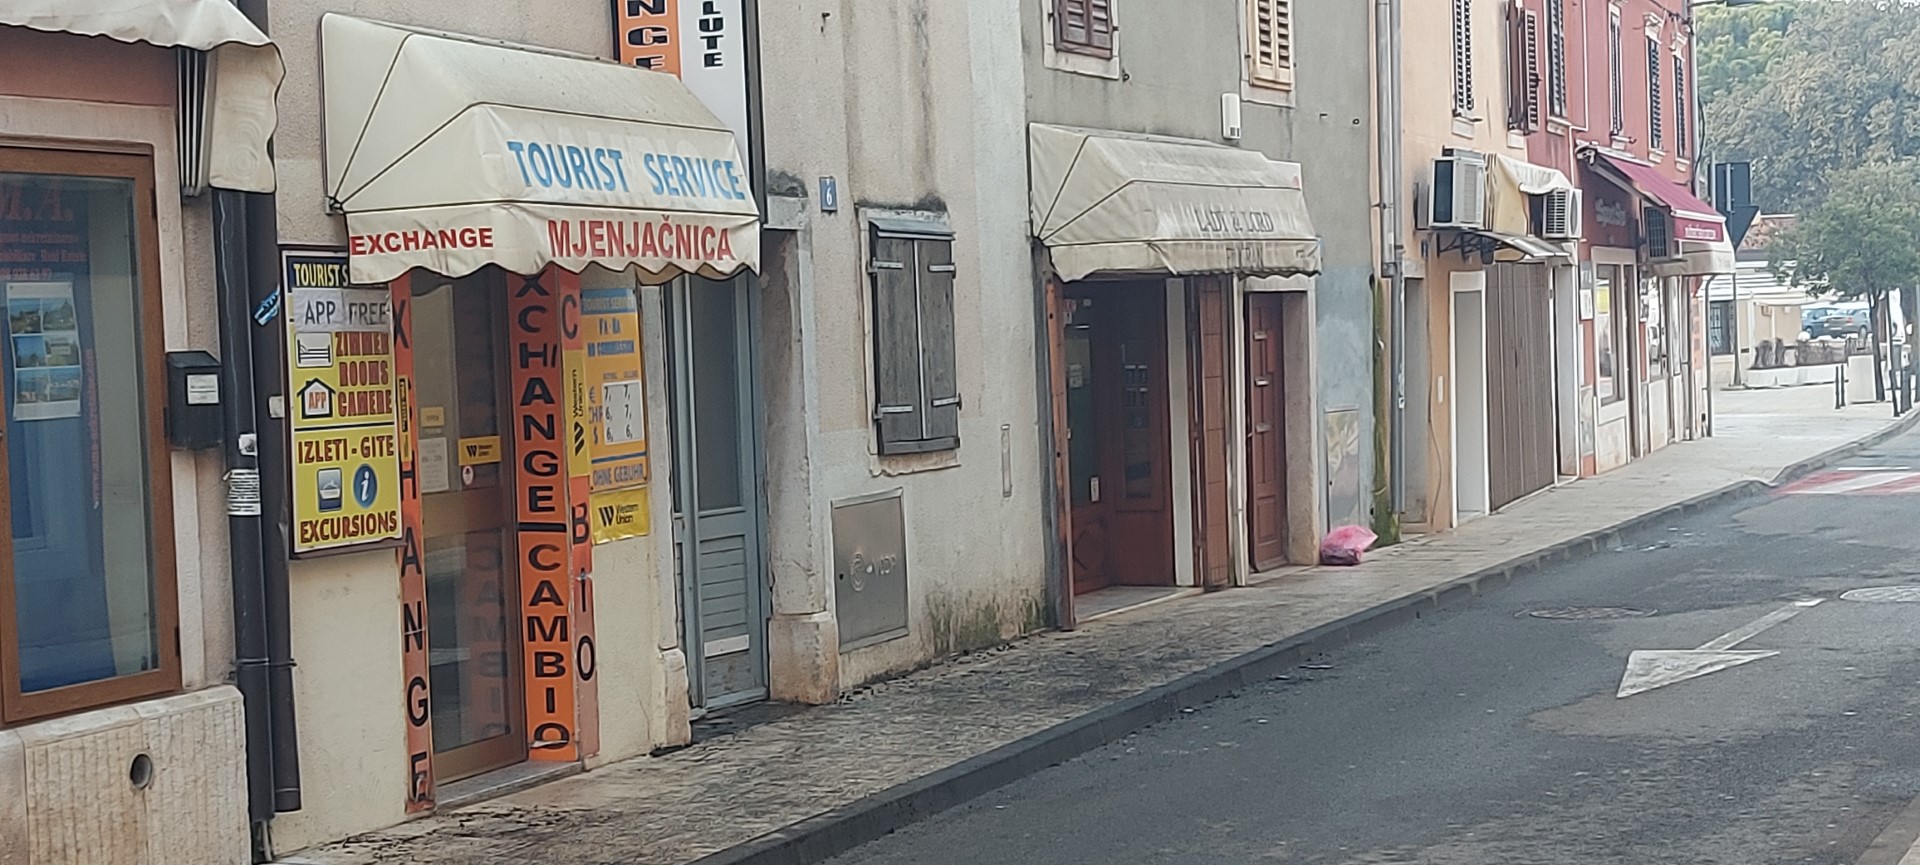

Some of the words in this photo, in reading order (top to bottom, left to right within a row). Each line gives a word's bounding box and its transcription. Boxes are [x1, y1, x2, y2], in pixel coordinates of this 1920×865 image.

[699, 1, 724, 67] LUTE
[507, 141, 629, 192] TOURIST
[644, 153, 746, 200] SERVICE
[826, 187, 833, 206] 6
[350, 228, 493, 256] EXCHANGE
[548, 214, 737, 262] MJENJAČNICA
[293, 263, 340, 287] TOURIST
[305, 301, 336, 325] APP
[336, 332, 389, 356] ZIMMER
[339, 361, 388, 386] ROOMS
[309, 391, 327, 410] APP
[338, 390, 392, 417] CAMERE
[298, 438, 348, 464] IZLETI
[360, 435, 394, 458] GITE
[300, 511, 397, 543] EXCURSIONS
[527, 544, 569, 748] CAMBIO
